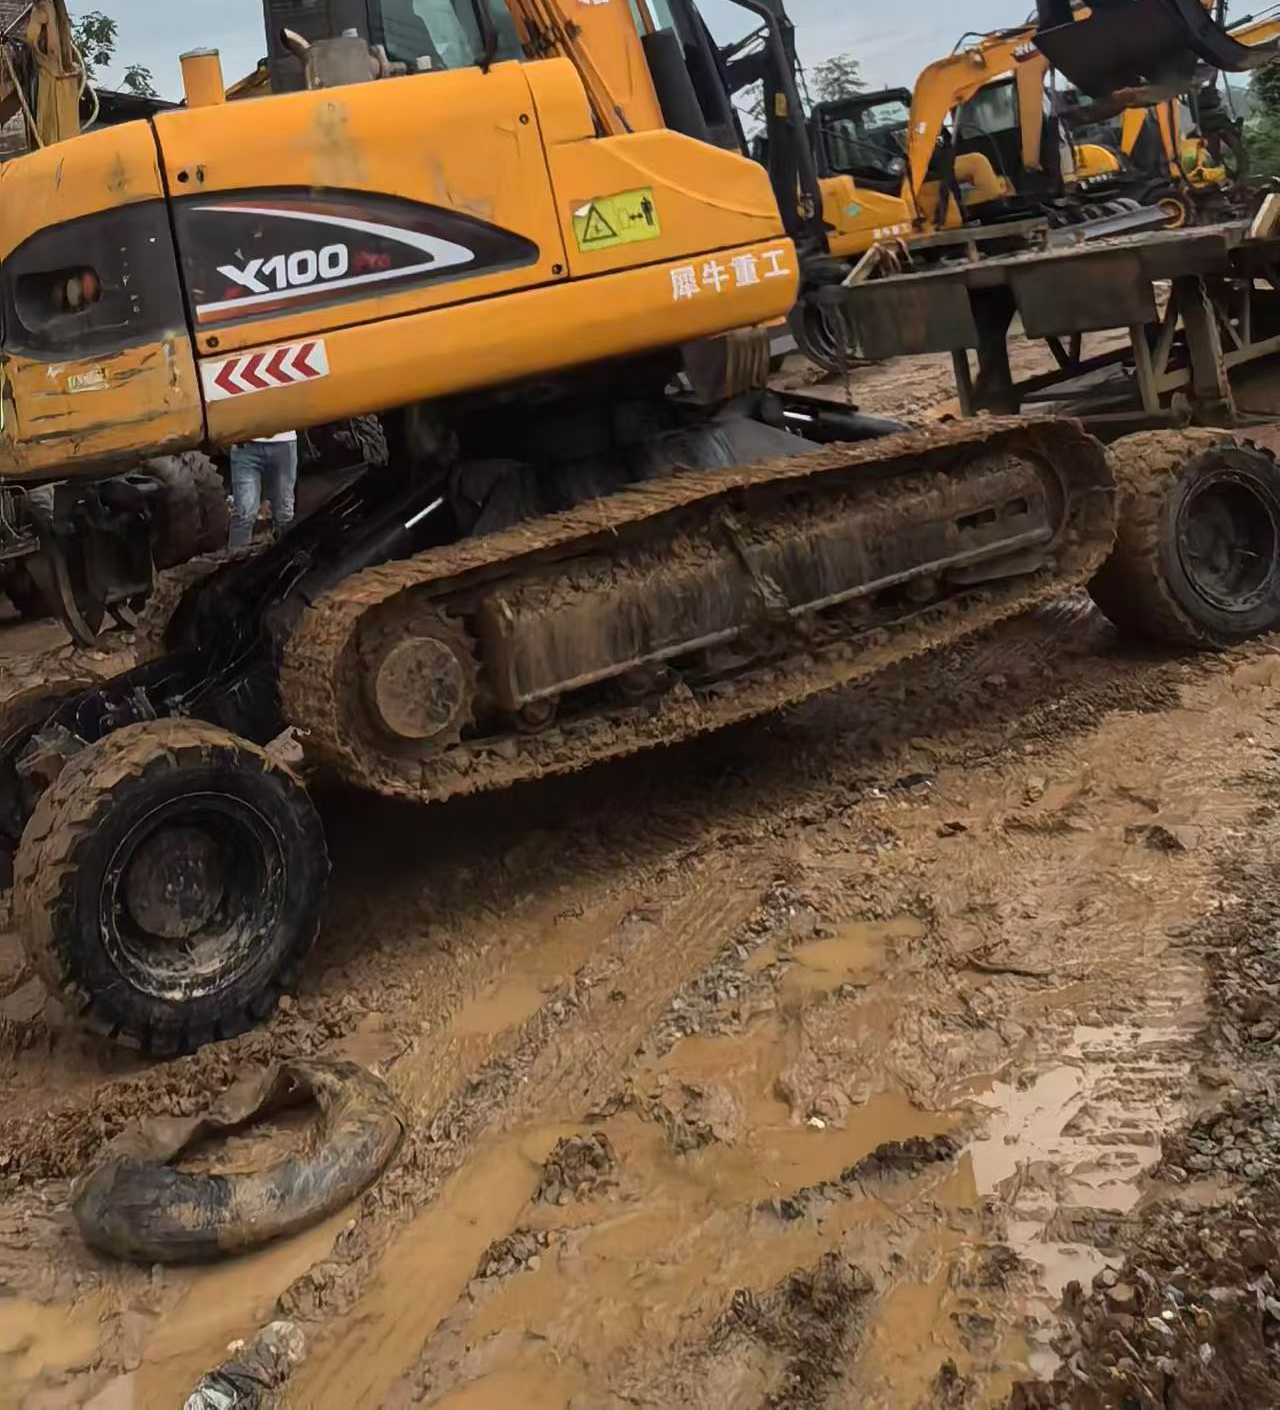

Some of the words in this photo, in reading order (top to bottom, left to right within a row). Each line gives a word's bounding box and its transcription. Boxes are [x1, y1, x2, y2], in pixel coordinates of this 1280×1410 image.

[216, 243, 348, 293] X100
[670, 250, 790, 301] 犀牛重工
